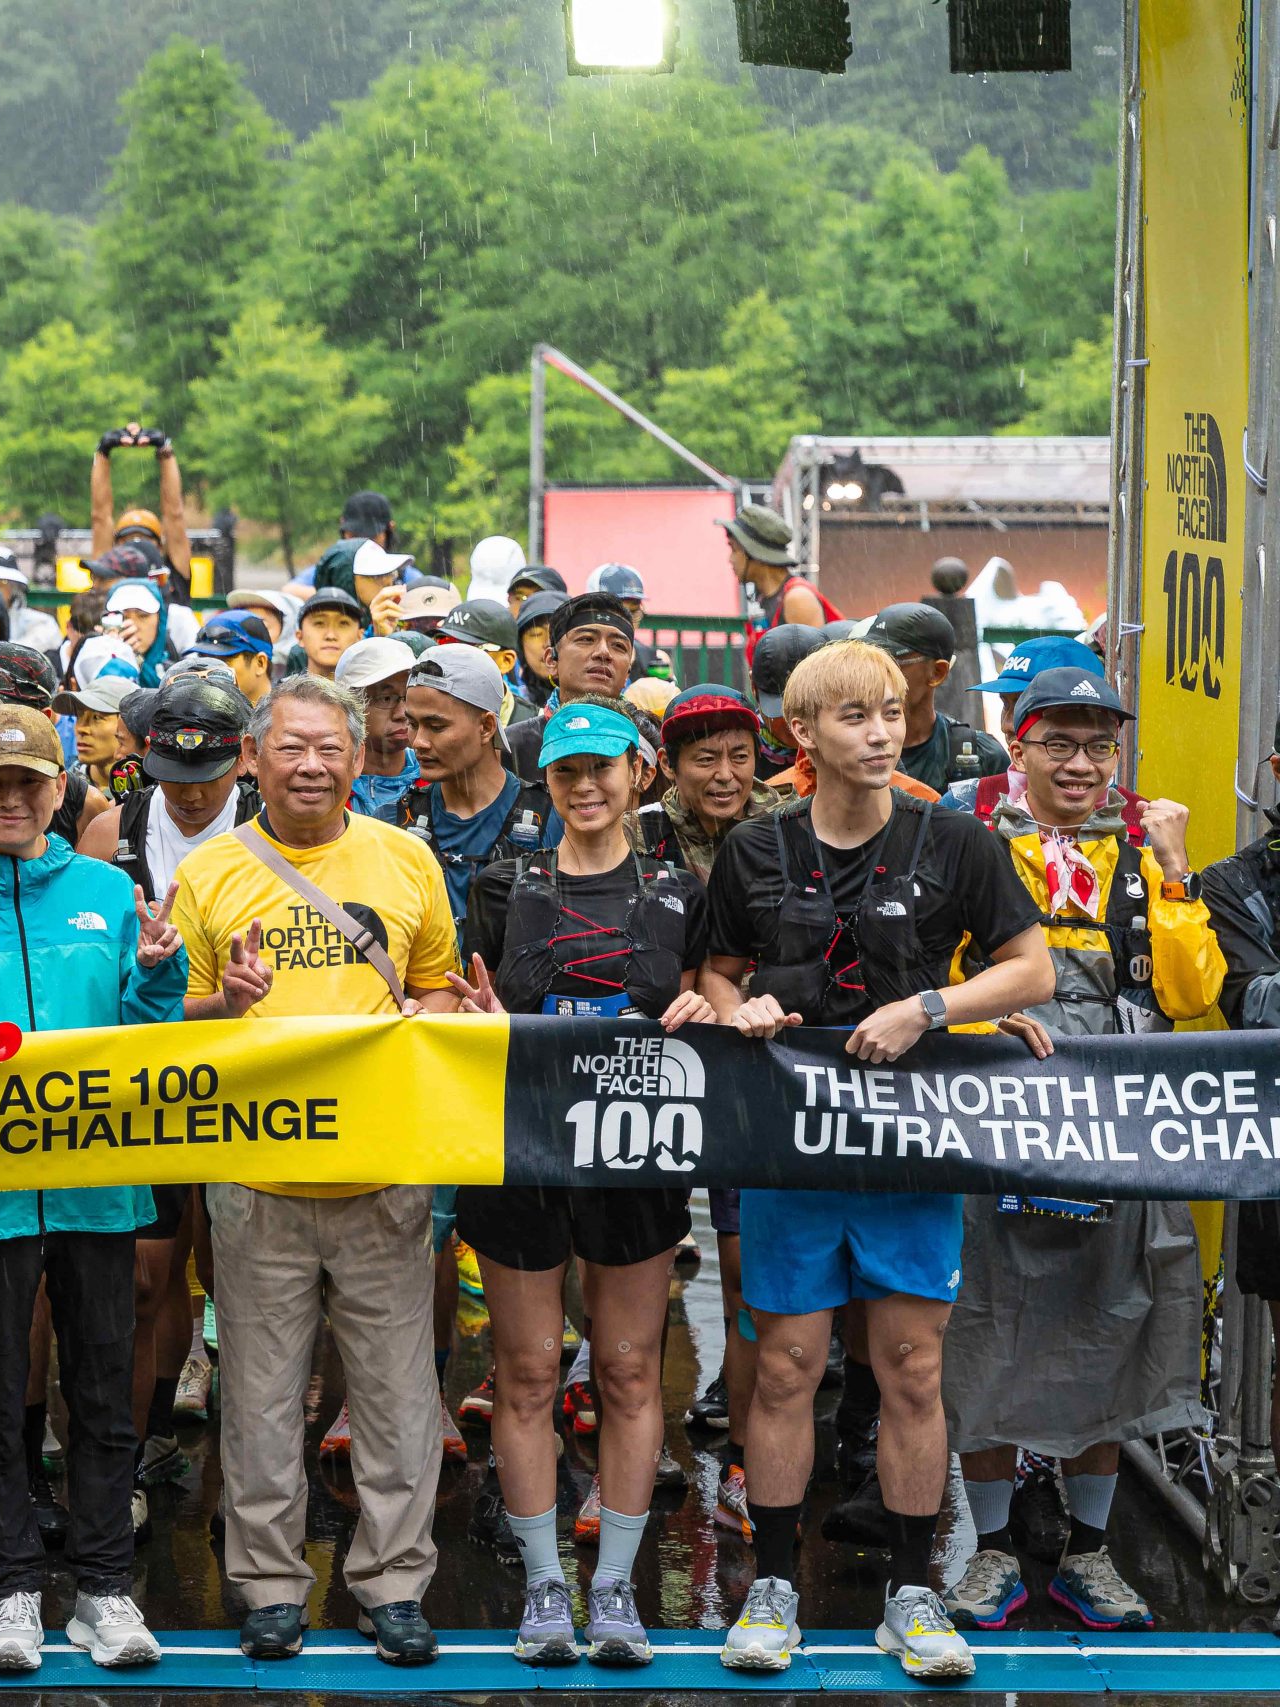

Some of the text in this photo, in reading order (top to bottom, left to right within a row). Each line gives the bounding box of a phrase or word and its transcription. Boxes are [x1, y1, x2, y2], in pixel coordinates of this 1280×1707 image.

[1184, 412, 1207, 453] THE
[1166, 452, 1206, 496] NORTH
[1177, 496, 1206, 540] FACE
[1163, 550, 1226, 700] 100
[1004, 656, 1031, 672] OKA
[1070, 690, 1101, 699] adidas
[288, 903, 340, 925] TH
[275, 945, 342, 971] FACE
[572, 1054, 660, 1076] NORTH
[614, 1036, 662, 1056] THE
[129, 1063, 219, 1106] 100
[595, 1074, 658, 1096] FACE
[793, 1063, 1259, 1117] THE NORTH FACE
[564, 1100, 703, 1172] 100
[793, 1110, 973, 1160] ULTRA
[979, 1119, 1139, 1162] TRAIL
